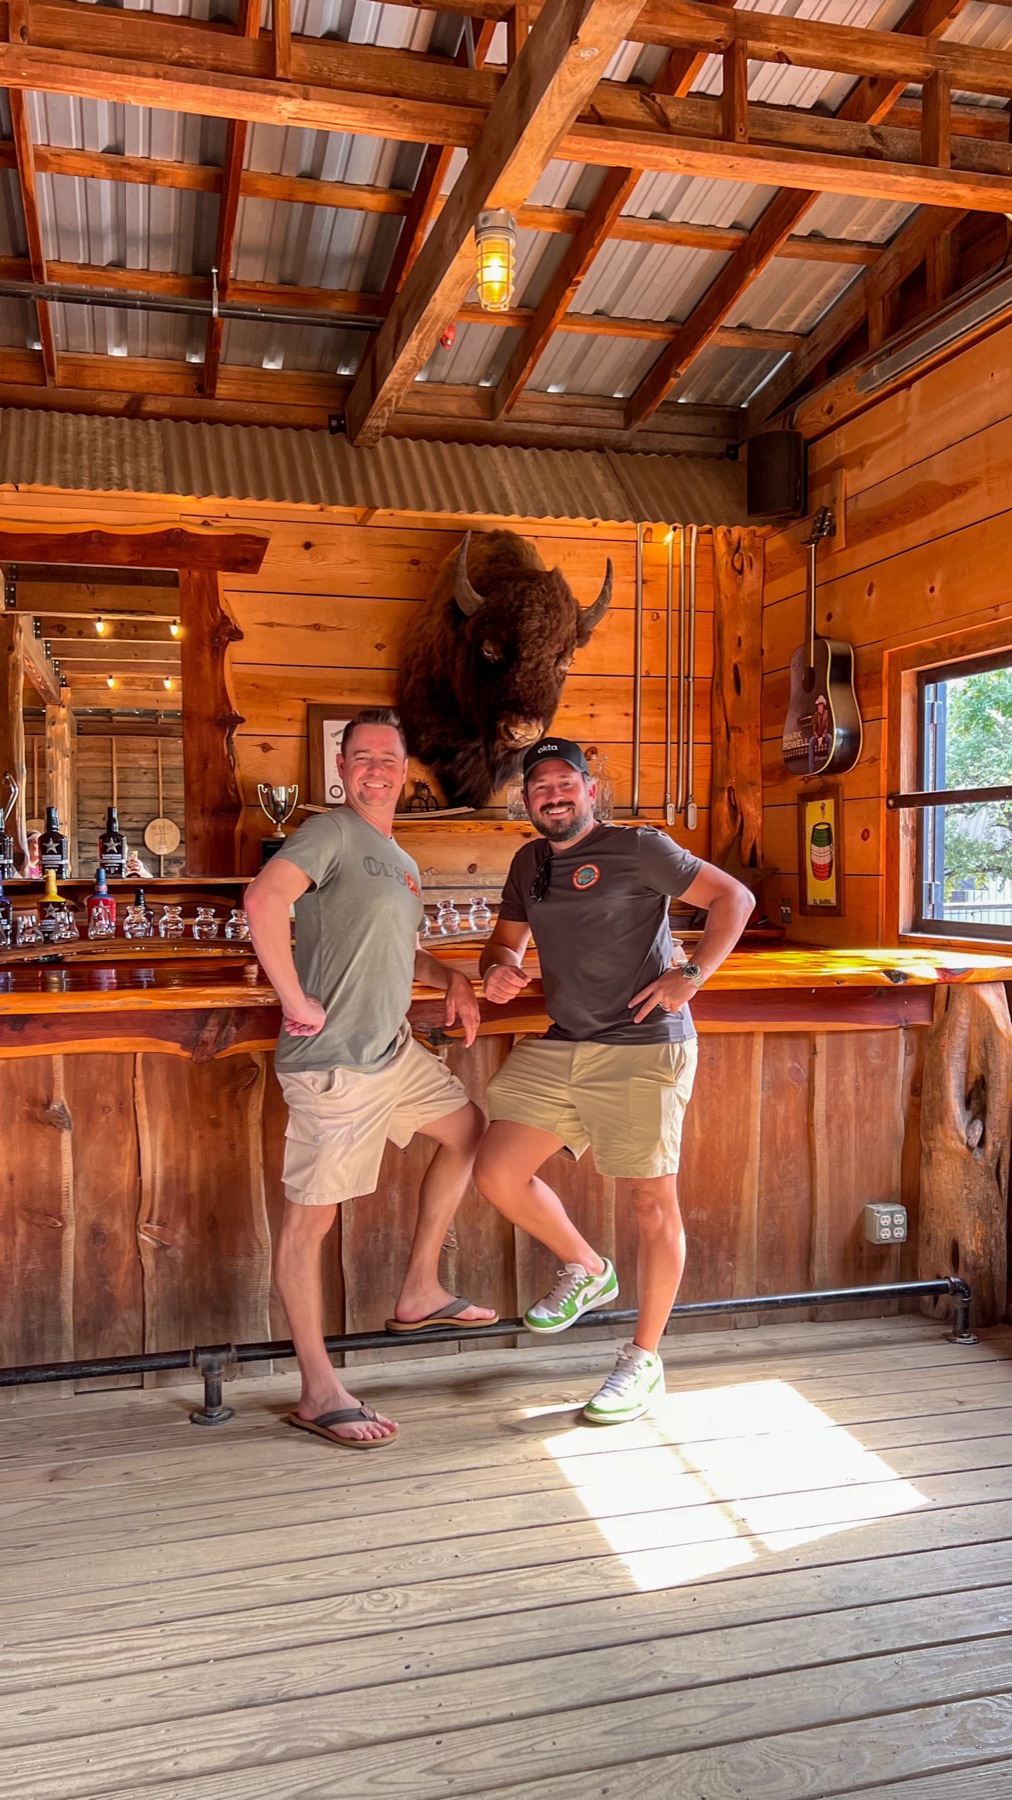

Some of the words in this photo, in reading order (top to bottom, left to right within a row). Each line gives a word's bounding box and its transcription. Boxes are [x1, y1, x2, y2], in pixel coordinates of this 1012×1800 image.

[783, 731, 802, 741] MARK
[537, 744, 558, 754] okta
[783, 738, 810, 750] POWELL
